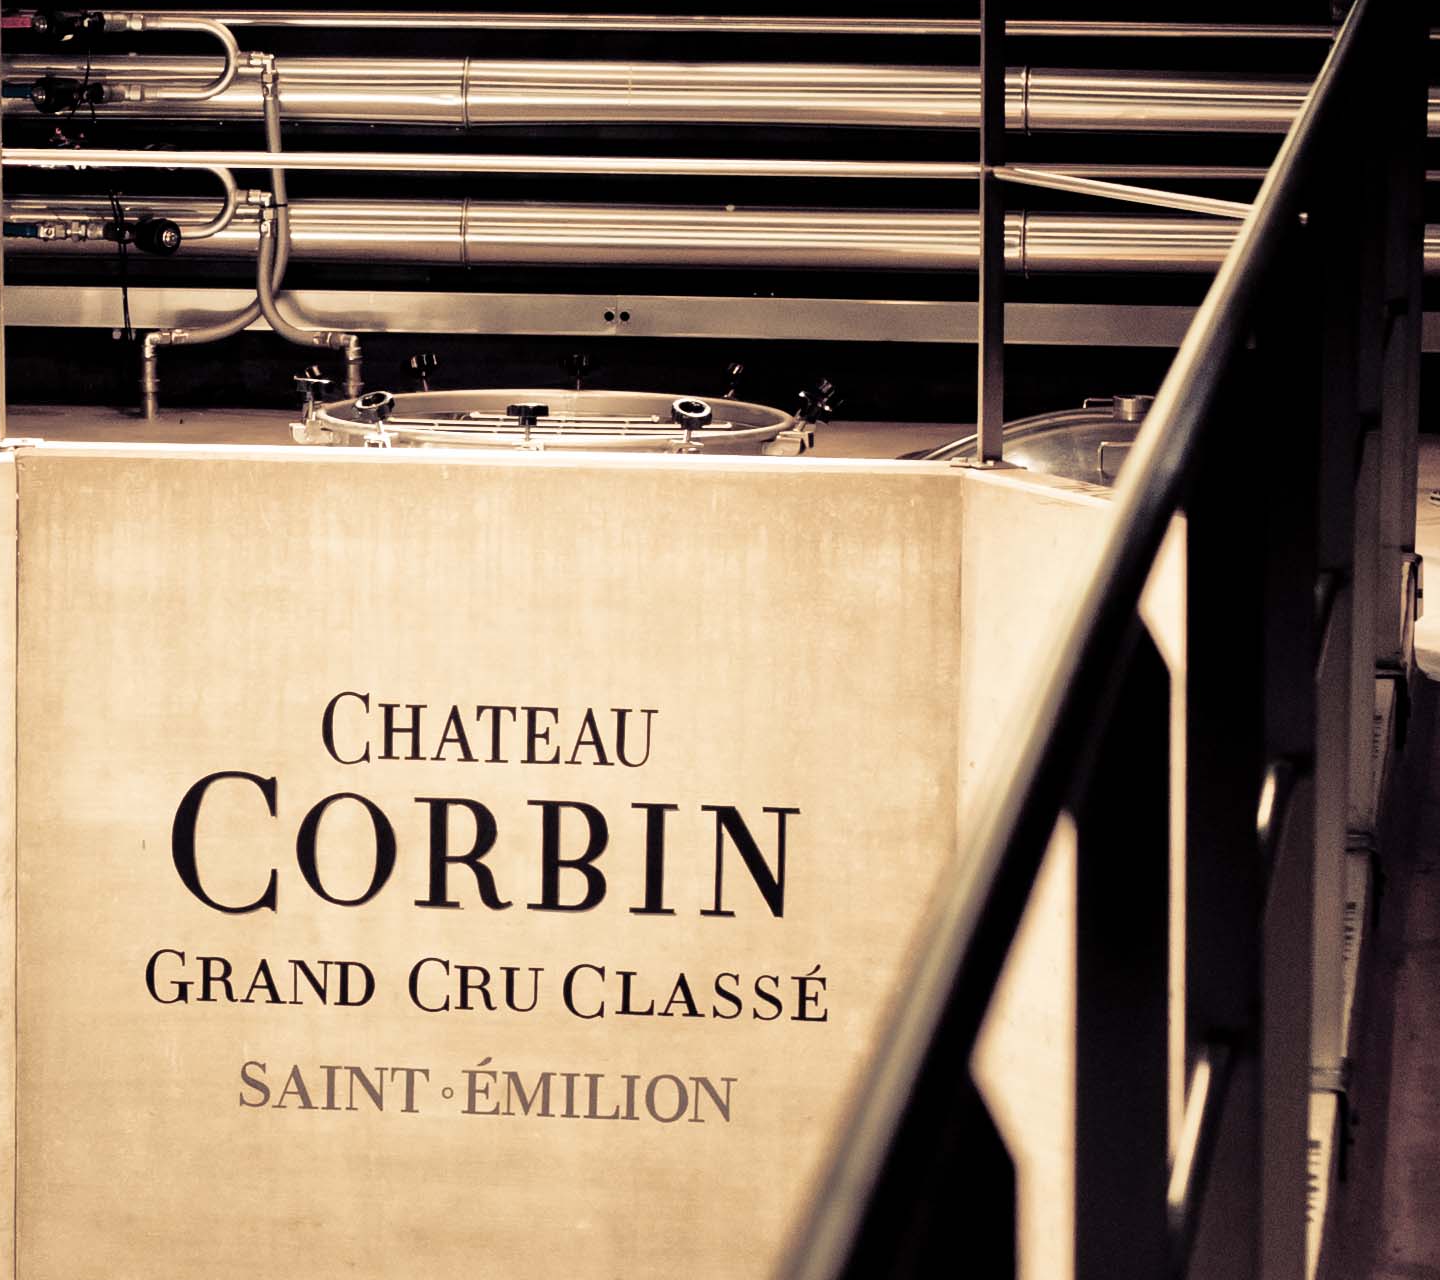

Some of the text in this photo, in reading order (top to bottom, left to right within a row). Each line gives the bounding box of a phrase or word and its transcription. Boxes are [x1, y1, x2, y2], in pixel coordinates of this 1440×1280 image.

[321, 691, 660, 768] CHATEAU
[171, 770, 802, 919] CORBIN
[144, 948, 829, 1023] GRAND CRU CLASSÉ
